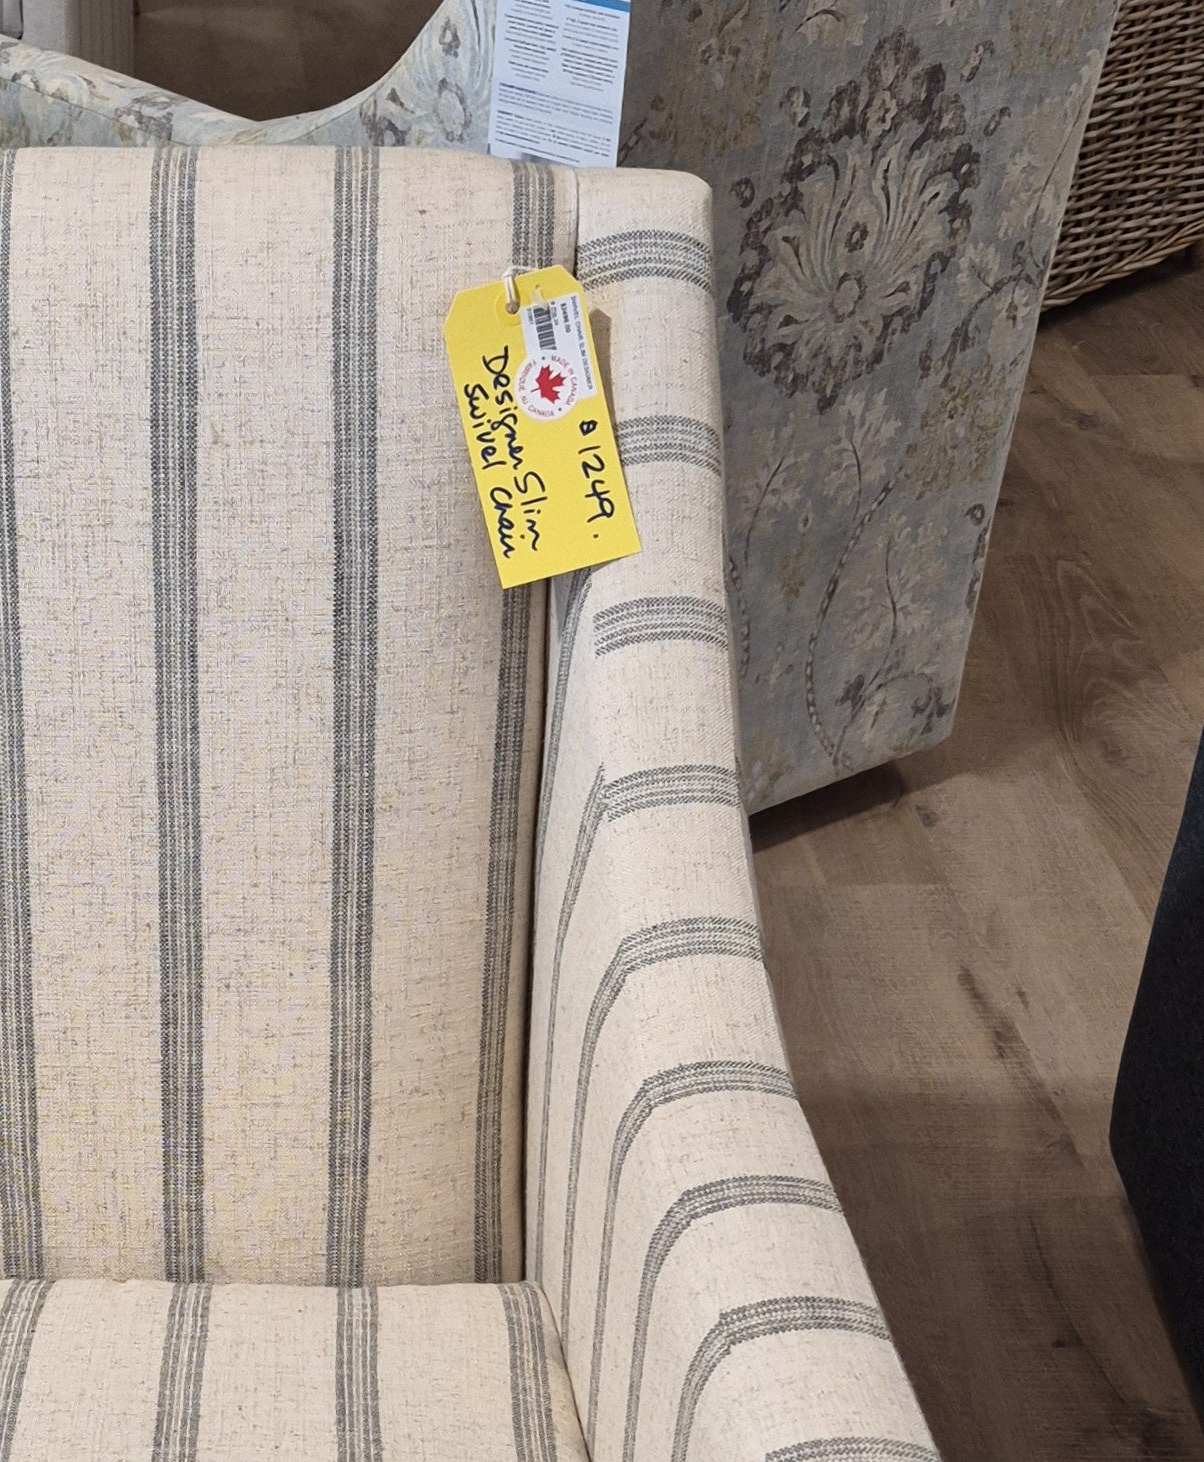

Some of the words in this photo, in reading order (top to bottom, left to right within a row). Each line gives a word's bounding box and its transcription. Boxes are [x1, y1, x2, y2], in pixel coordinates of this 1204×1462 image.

[551, 354, 570, 370] MADE
[567, 367, 575, 376] IN
[565, 376, 578, 406] CANADA
[527, 404, 555, 418] CANADA
[482, 345, 524, 471] Designer
[513, 471, 548, 552] Slim
[464, 384, 507, 470] Swivel
[490, 486, 526, 559] Chair
